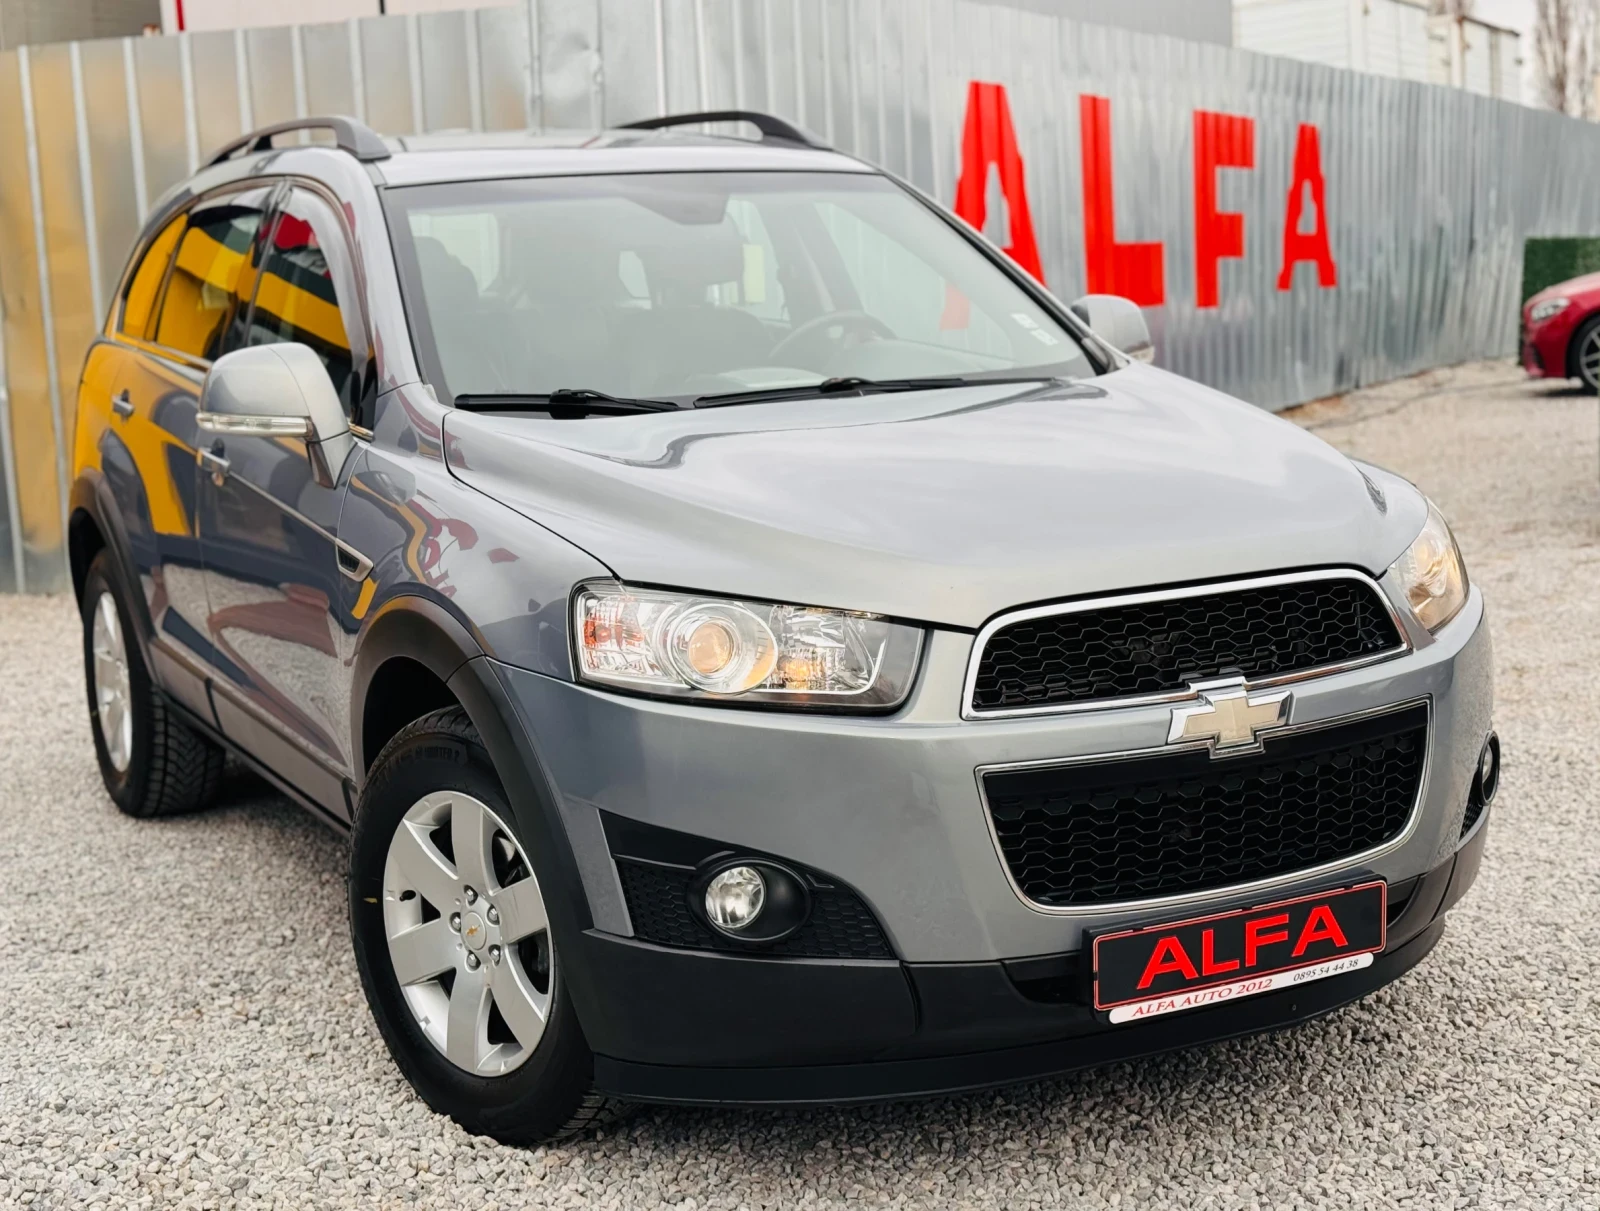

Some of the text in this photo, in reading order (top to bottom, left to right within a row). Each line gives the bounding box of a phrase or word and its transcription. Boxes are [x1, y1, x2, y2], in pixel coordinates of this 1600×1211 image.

[953, 81, 1337, 309] ALFA
[1131, 958, 1359, 1018] ALFA AUTO 2012 0895 54 44 38
[1136, 904, 1349, 990] ALFA
